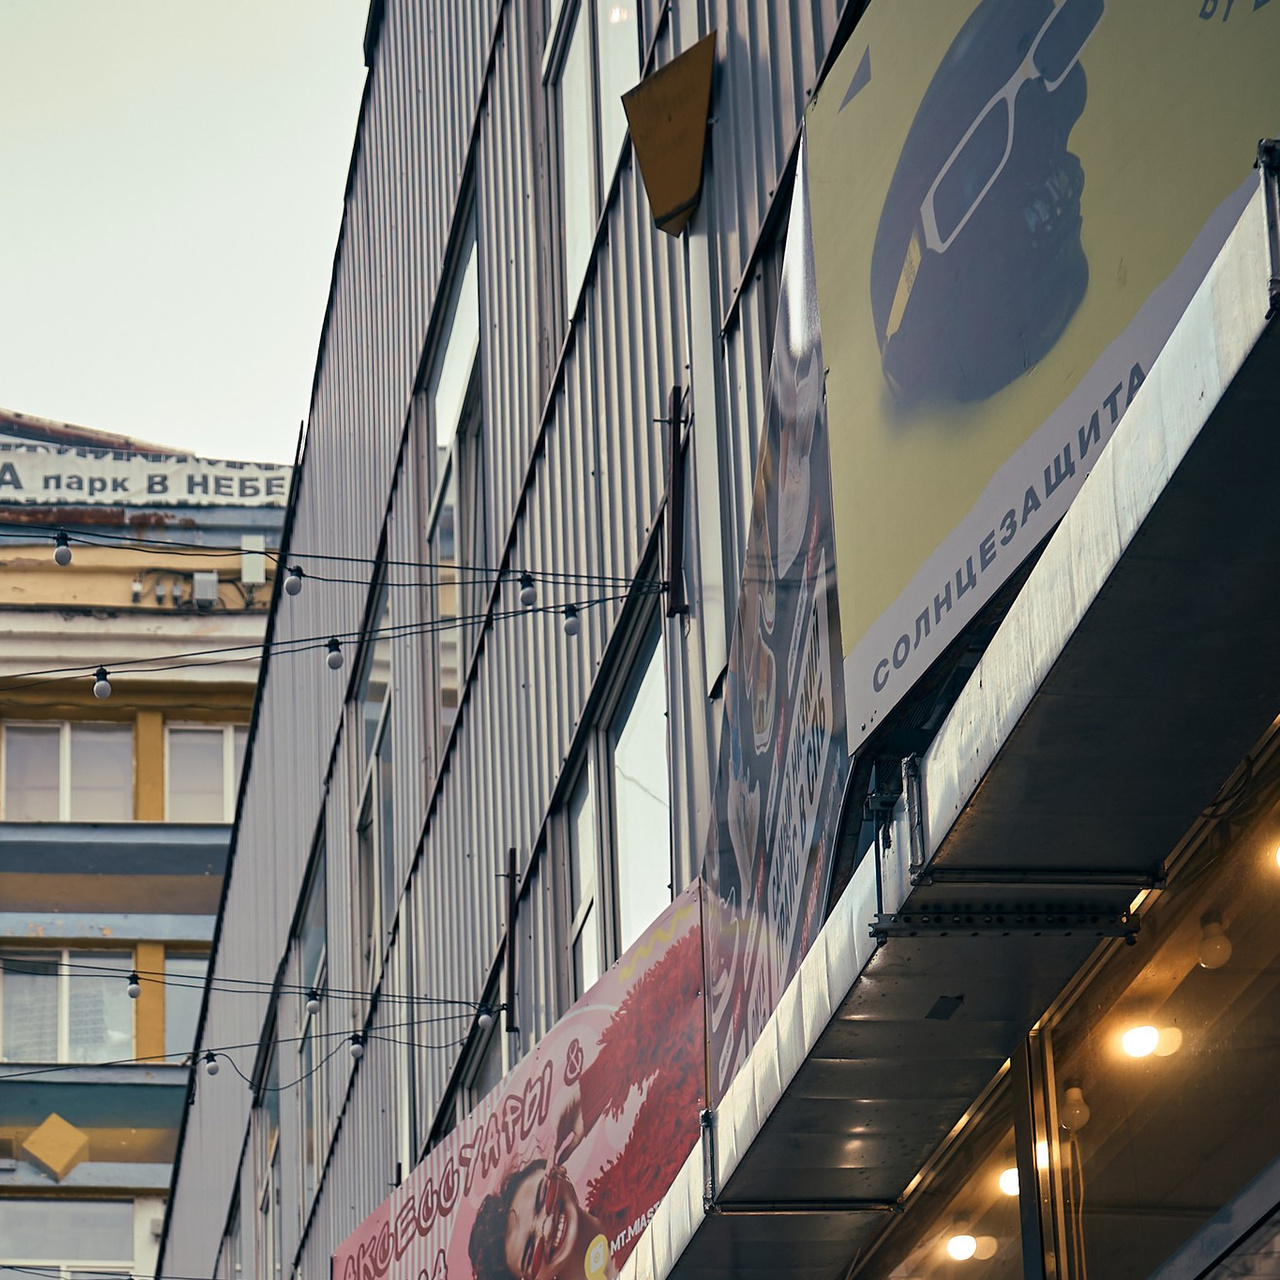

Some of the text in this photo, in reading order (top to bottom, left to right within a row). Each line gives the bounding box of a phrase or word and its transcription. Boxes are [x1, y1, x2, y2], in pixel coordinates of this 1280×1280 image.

[43, 474, 131, 497] парк
[147, 473, 169, 494] В
[186, 474, 286, 498] НЕБЕ
[872, 361, 1147, 694] СОЛНЦЕЗАЩИТА
[564, 1037, 584, 1088] &
